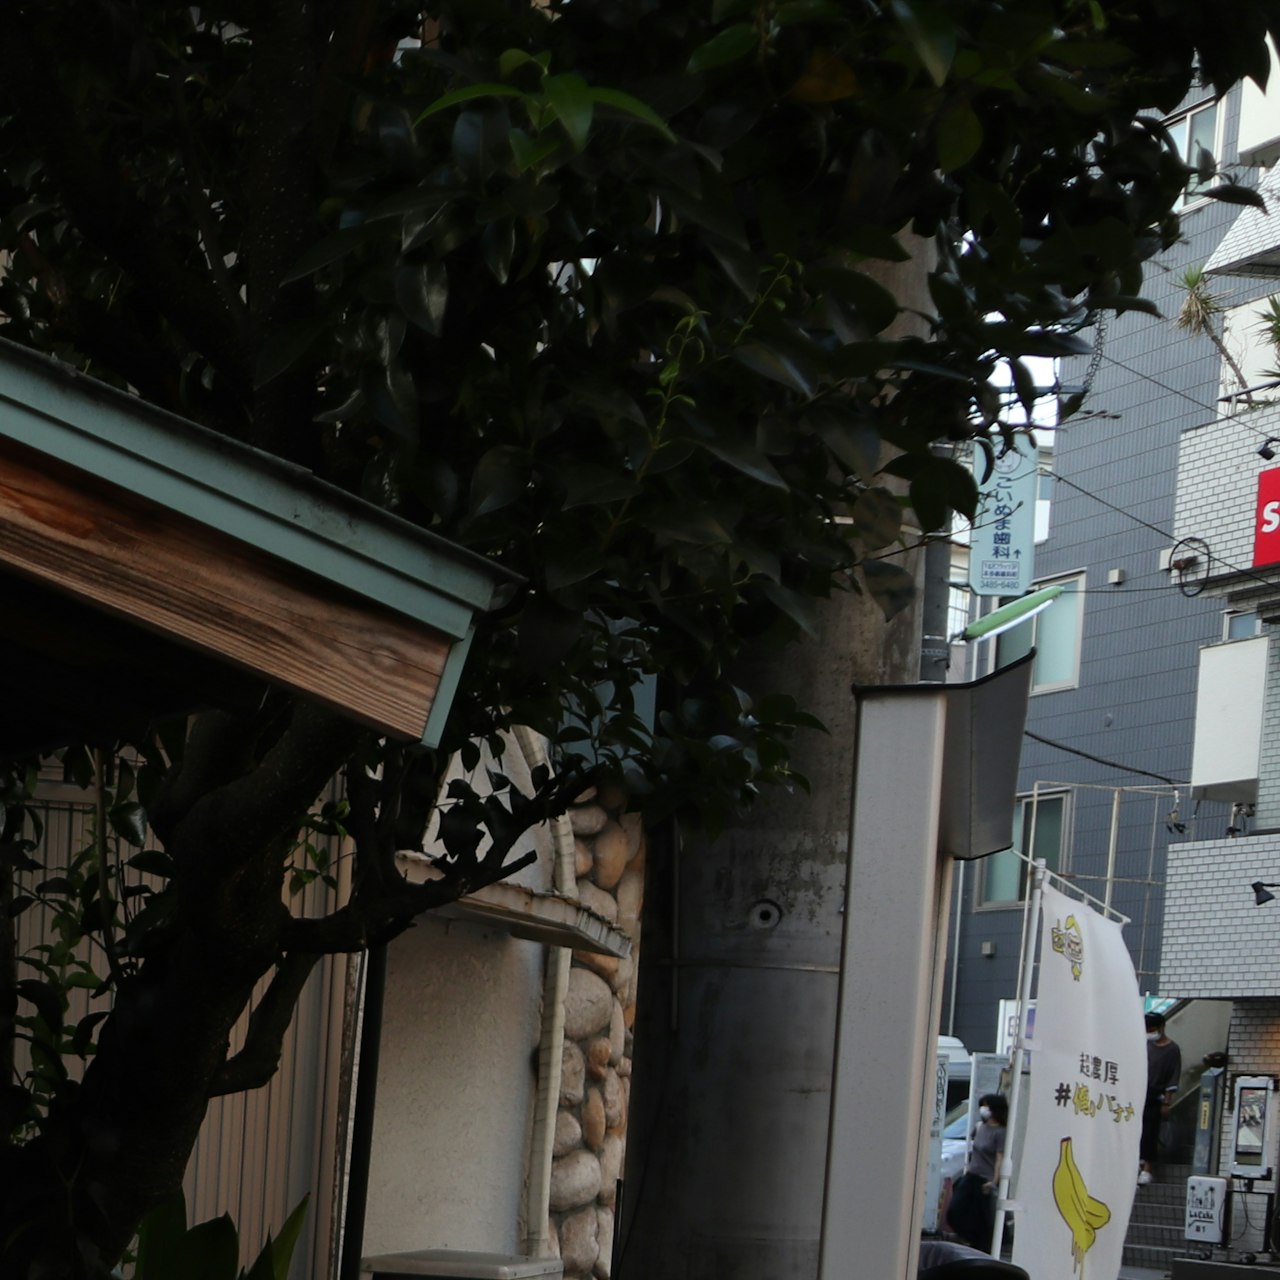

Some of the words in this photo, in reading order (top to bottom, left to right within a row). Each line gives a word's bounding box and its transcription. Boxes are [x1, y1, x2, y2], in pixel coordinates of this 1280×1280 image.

[992, 476, 1013, 559] こいぬま歯科
[1079, 1052, 1120, 1086] 超濃厚
